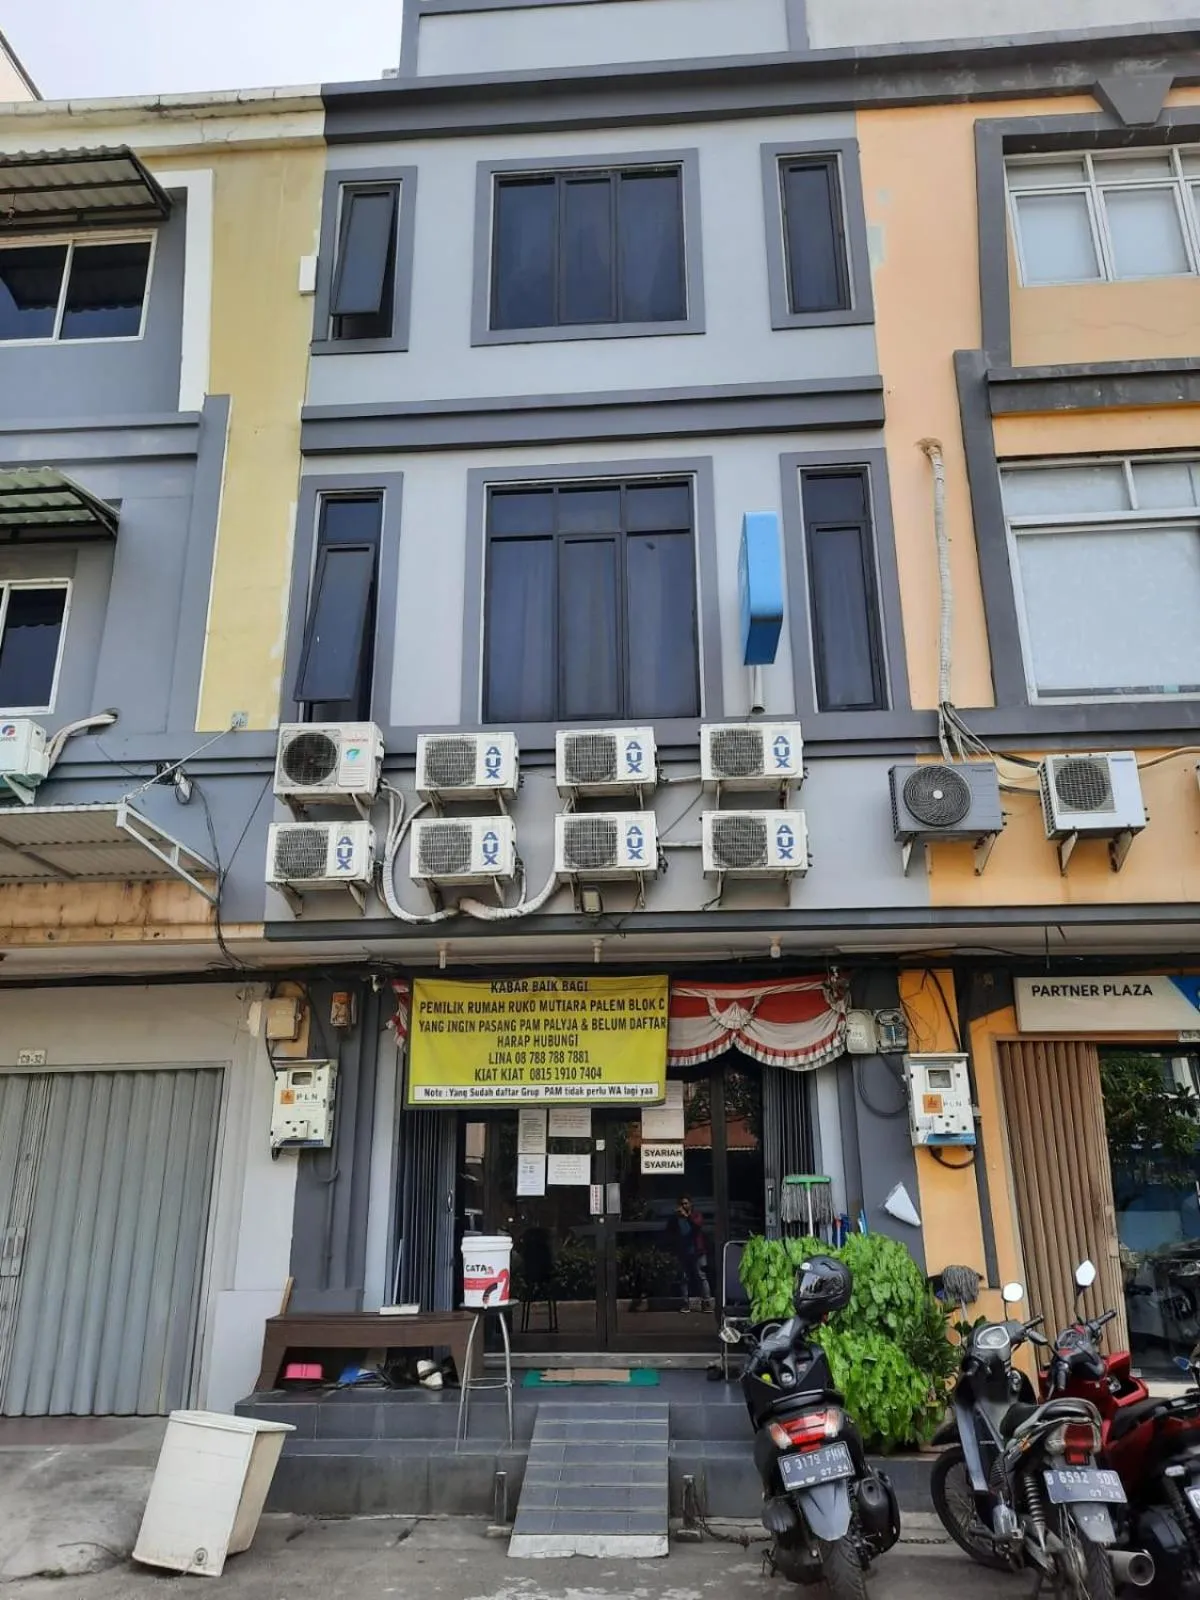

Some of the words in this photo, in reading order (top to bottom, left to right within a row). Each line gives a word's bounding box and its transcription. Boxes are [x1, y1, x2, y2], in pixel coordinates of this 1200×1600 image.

[626, 741, 643, 773] AUX
[773, 735, 790, 768] AUX
[485, 746, 502, 778] AUX
[482, 831, 498, 865] AUX
[626, 826, 643, 860] AUX
[777, 824, 794, 859] AUX
[337, 836, 353, 870] AUX
[490, 980, 529, 993] KABAR
[532, 980, 558, 992] BAIK
[561, 980, 588, 992] BAGI
[1031, 984, 1100, 997] PARTNER
[1103, 984, 1153, 996] PLAZA
[420, 1001, 464, 1014] PEMILIK
[468, 1001, 505, 1013] RUMAH
[508, 1000, 536, 1013] RUKO
[539, 1000, 587, 1012] MUTIARA
[590, 999, 625, 1012] PALEM
[629, 998, 656, 1011] BLOK
[658, 998, 665, 1010] C
[419, 1020, 444, 1033] YANG
[447, 1020, 475, 1033] INGIN
[479, 1019, 517, 1032] PASANG
[519, 1019, 540, 1031] PAM
[543, 1018, 578, 1031] PALYJA
[581, 1019, 589, 1030] &
[591, 1018, 627, 1030] BELUM
[629, 1016, 666, 1030] DAFTAR
[497, 1036, 531, 1048] HARAP
[533, 1034, 578, 1047] HUBUNGI
[488, 1052, 512, 1065] LINA
[530, 1051, 546, 1064] 788
[549, 1051, 565, 1063] 788
[568, 1050, 589, 1063] 7881
[475, 1068, 497, 1081] KIAT
[501, 1068, 524, 1081] KIAT
[529, 1068, 552, 1081] 0815
[555, 1067, 577, 1080] 1910
[580, 1066, 602, 1080] 7404
[424, 1088, 442, 1098] Note
[470, 1087, 493, 1098] Sudah
[496, 1087, 519, 1097] daftar
[521, 1086, 540, 1099] Grup
[544, 1086, 562, 1097] PAM
[565, 1086, 584, 1096] tidak
[586, 1085, 606, 1097] perlu
[608, 1085, 621, 1095] WA
[624, 1084, 638, 1097] lagi
[640, 1086, 653, 1097] yaa
[644, 1149, 683, 1157] SYARIAH
